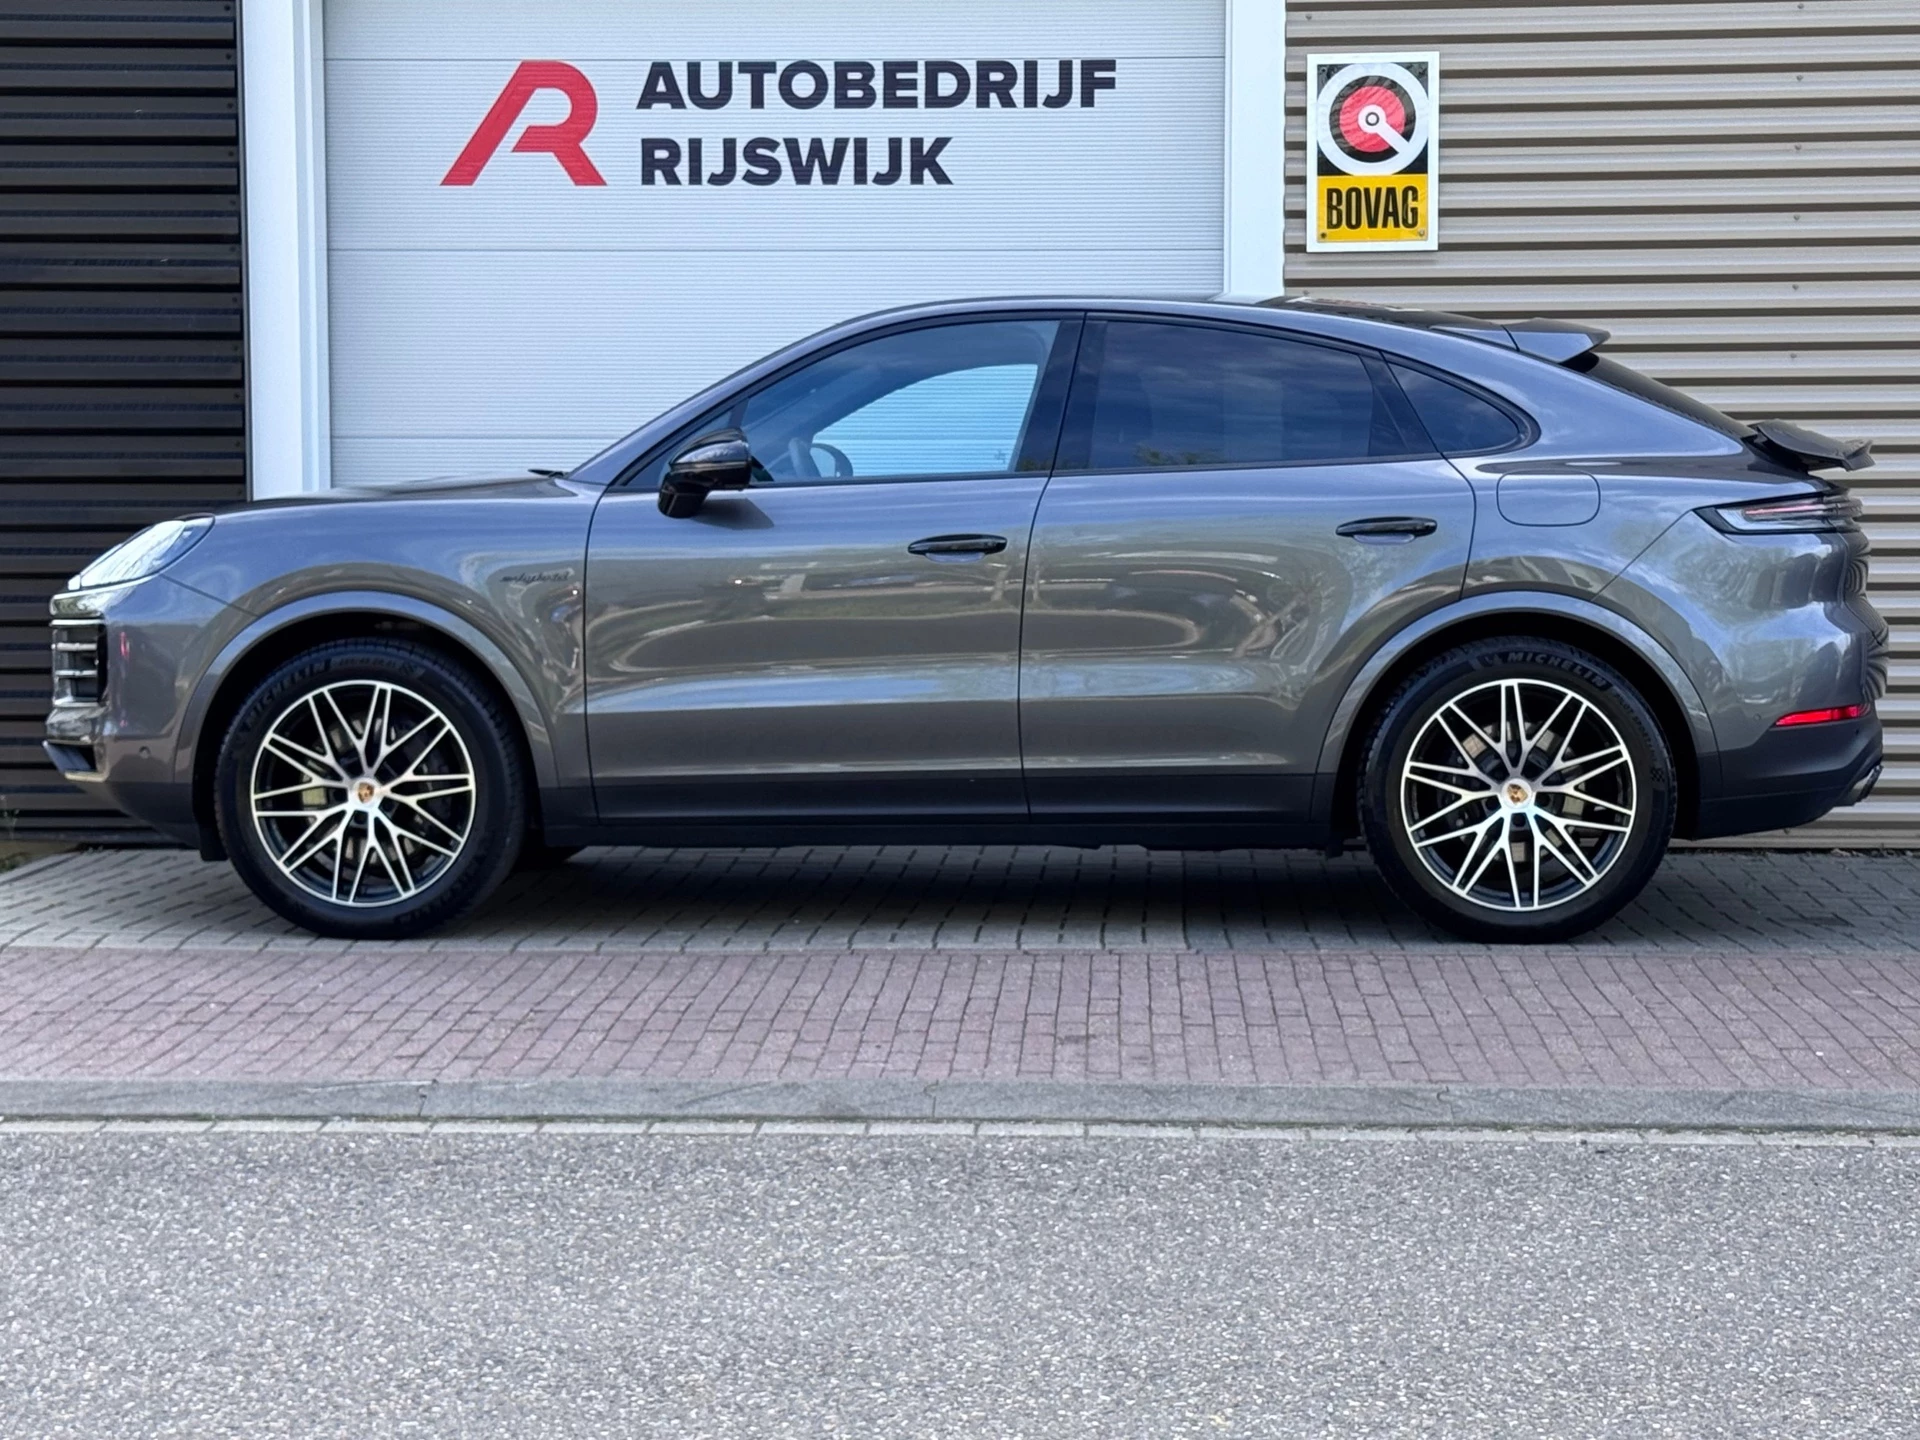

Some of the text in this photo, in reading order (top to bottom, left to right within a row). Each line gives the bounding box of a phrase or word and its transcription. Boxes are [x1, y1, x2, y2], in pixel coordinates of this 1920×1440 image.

[636, 59, 1117, 110] AUTOBEDRIJF
[641, 137, 953, 186] RIJSWIJK
[1326, 186, 1419, 230] BOVAG
[1507, 651, 1609, 688] MICHELIN
